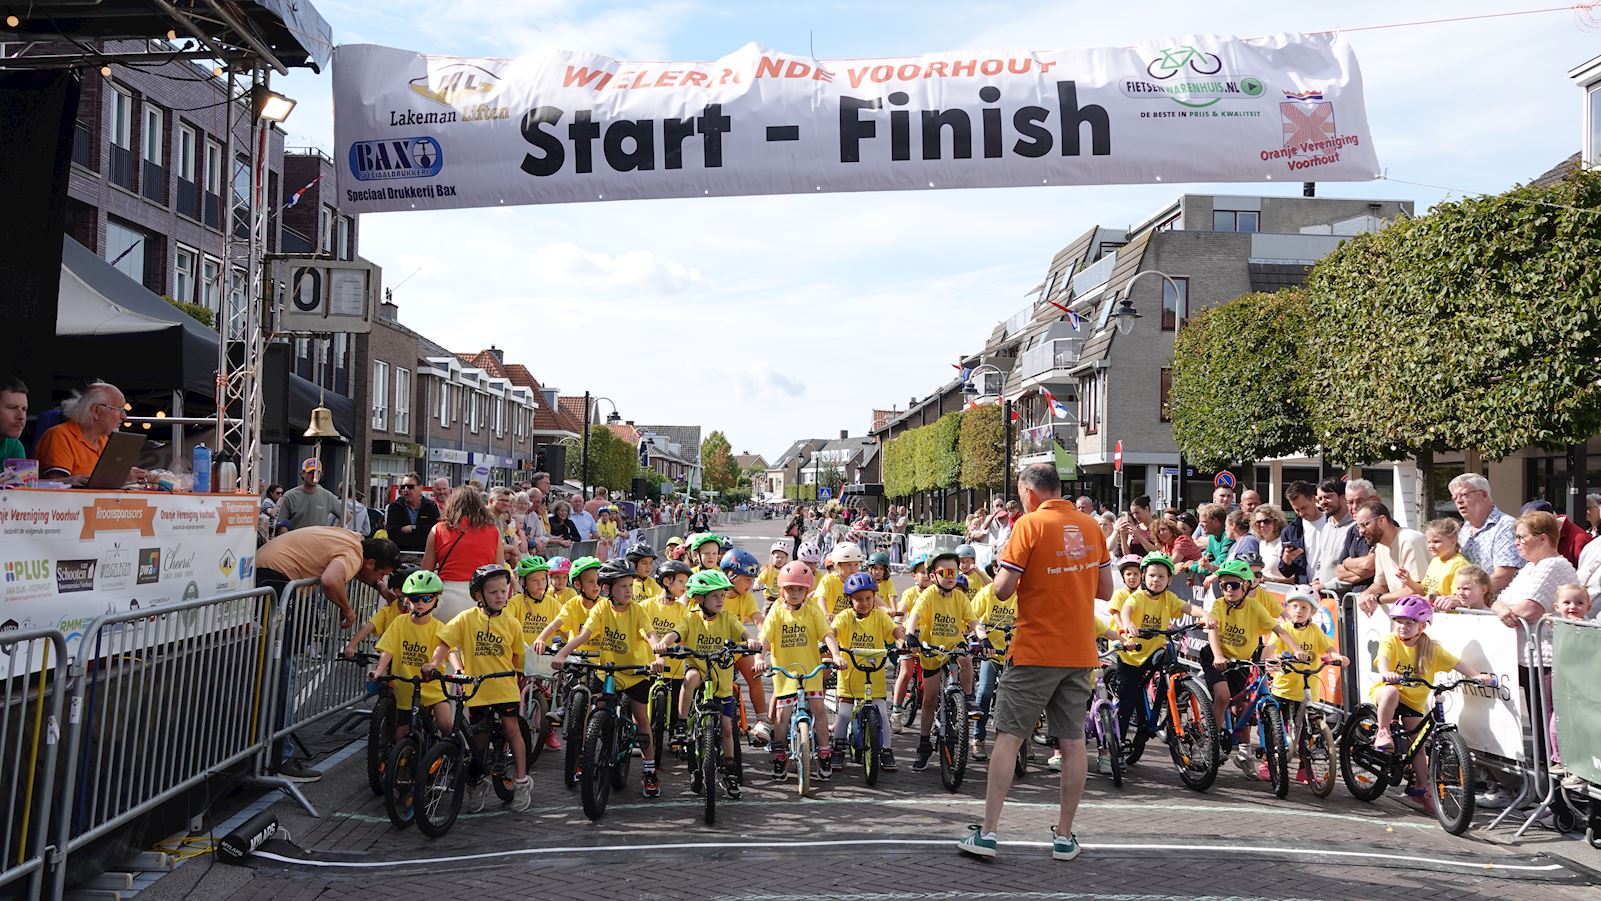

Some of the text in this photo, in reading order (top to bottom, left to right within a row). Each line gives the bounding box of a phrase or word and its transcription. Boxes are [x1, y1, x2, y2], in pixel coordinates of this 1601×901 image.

[847, 58, 1056, 89] VOORHOUT
[1126, 81, 1240, 95] FIETSENWARENHUIS.NL
[390, 104, 510, 126] Lakeman Liften
[1189, 110, 1210, 118] PRIJS
[1221, 110, 1261, 118] KWALITEIT
[519, 80, 1111, 177] Start - Finish
[1260, 133, 1359, 161] Oranje Vereniging
[356, 140, 412, 172] BAX
[1287, 152, 1341, 171] Voorhout
[360, 169, 434, 179] SPECIAALDRUKKERIJ
[347, 184, 457, 202] Speciaal Drukkerij Bax
[293, 266, 321, 311] 0
[11, 508, 50, 524] Vereniging
[51, 508, 80, 521] Voorhout
[96, 506, 143, 521] Kroonsponsors
[160, 510, 176, 522] Oranje
[177, 510, 199, 522] Vereniging
[163, 543, 196, 572] Cheers!
[14, 559, 50, 581] PLUS
[57, 567, 87, 582] Schooten
[836, 595, 852, 604] Rab
[992, 604, 1015, 615] Rabo
[524, 612, 548, 623] Rabo
[652, 616, 675, 629] Rabo
[934, 613, 956, 624] Rabo
[1142, 614, 1162, 625] Rabo
[60, 619, 81, 632] RMM
[782, 623, 806, 635] Rabo
[476, 631, 503, 644] Rabo
[605, 626, 627, 641] Rabo
[697, 633, 722, 645] Rabo
[851, 632, 874, 643] Rabo
[402, 640, 427, 654] Rabo
[221, 841, 244, 857] MYLAPS
